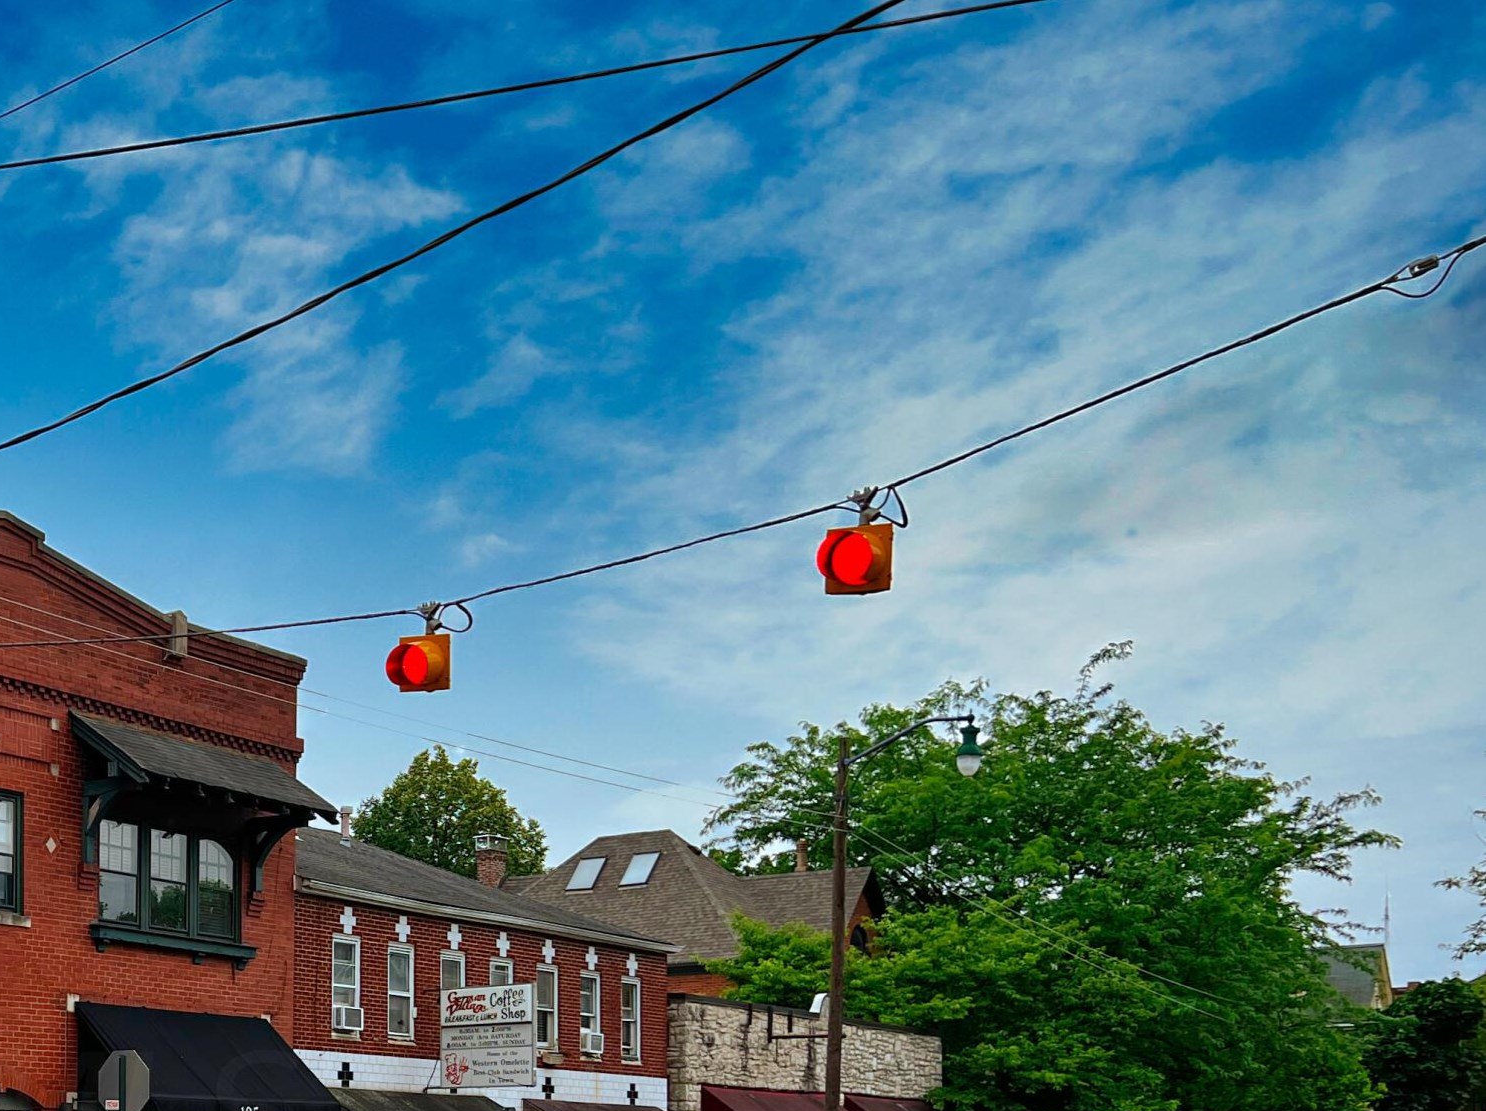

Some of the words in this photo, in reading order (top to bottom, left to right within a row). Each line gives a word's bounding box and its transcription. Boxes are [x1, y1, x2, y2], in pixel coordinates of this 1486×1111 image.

[447, 991, 486, 1003] German
[490, 988, 524, 1007] Coffee
[444, 1014, 475, 1023] BREAKFAST
[480, 1013, 498, 1021] LUNCH
[501, 1007, 526, 1021] Shop
